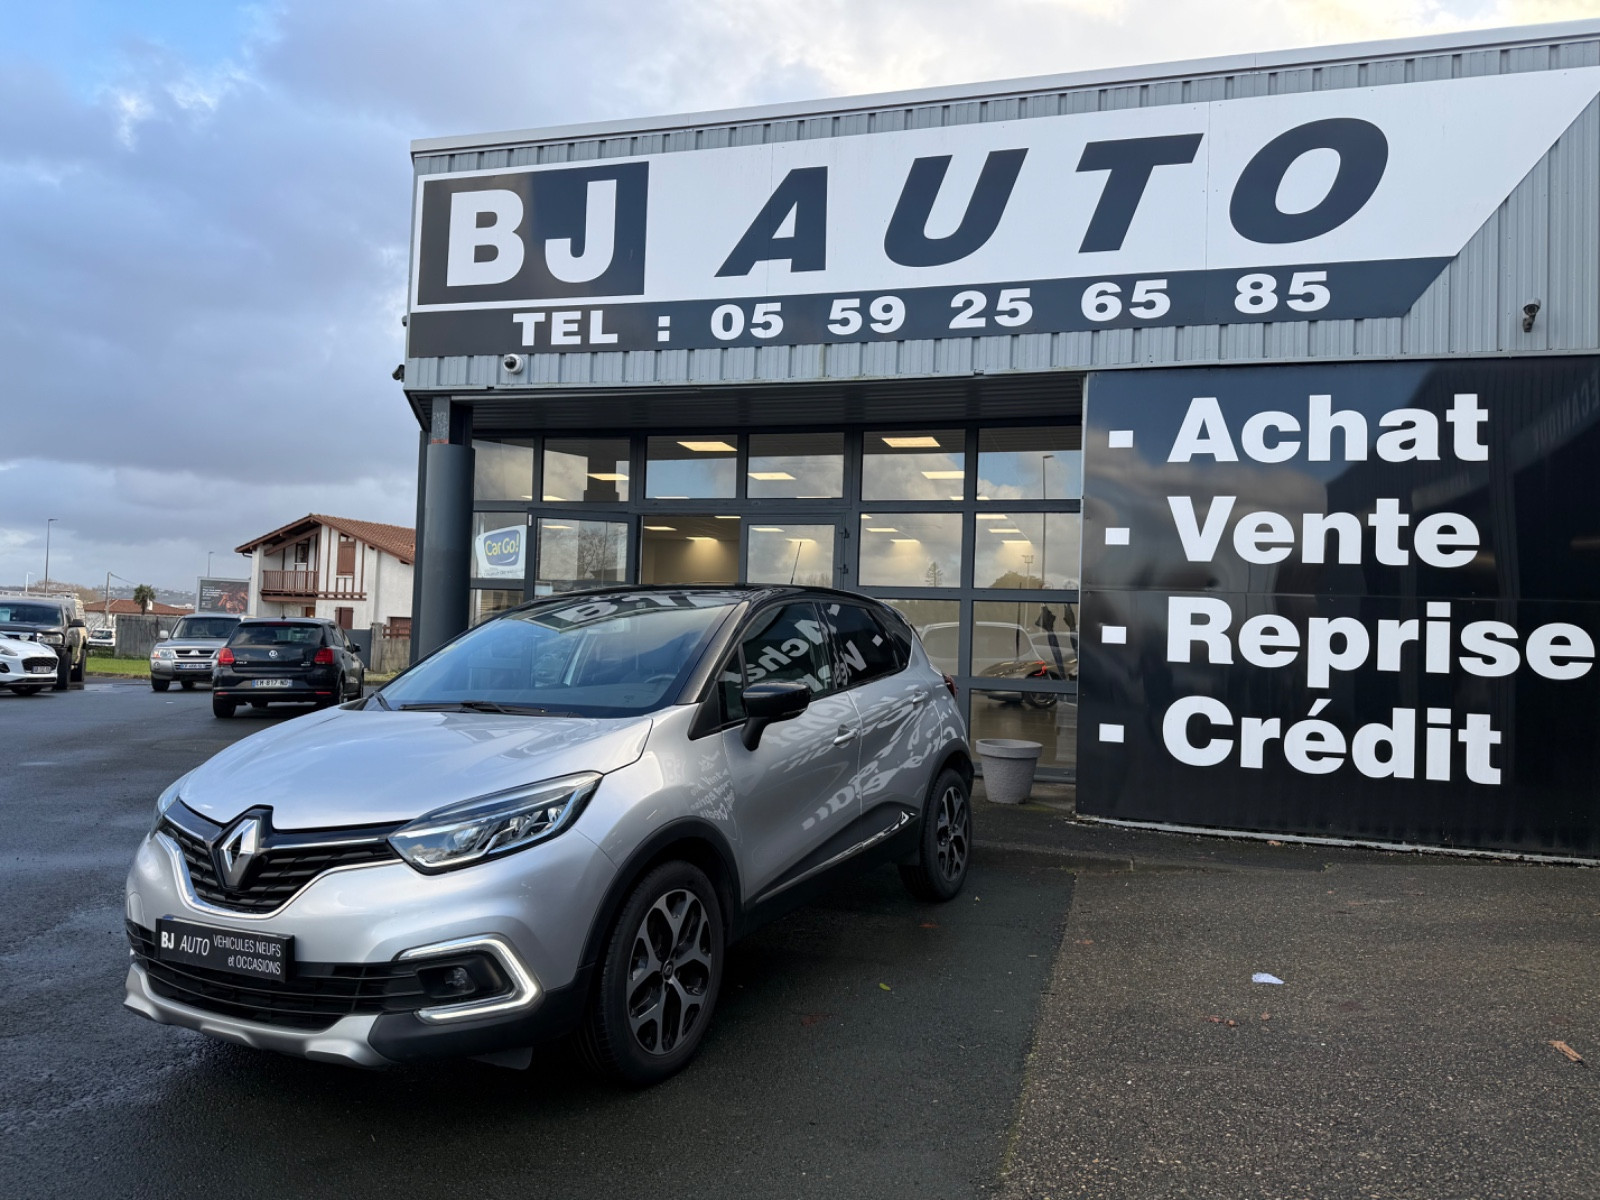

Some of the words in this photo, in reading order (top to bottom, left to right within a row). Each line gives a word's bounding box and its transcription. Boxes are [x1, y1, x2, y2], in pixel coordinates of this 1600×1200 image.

[447, 179, 617, 287] BJ
[714, 117, 1389, 278] AUTO
[513, 310, 618, 347] TEL
[711, 302, 784, 341] 05
[827, 295, 906, 335] 59
[948, 288, 1034, 329] 25
[1081, 279, 1171, 322] 65
[1234, 271, 1331, 314] 85
[1167, 393, 1489, 463] Achat
[1167, 496, 1480, 568] Vente
[1167, 596, 1596, 689] Reprise
[1162, 695, 1502, 785] Crédit
[161, 931, 175, 950] BJ
[179, 935, 210, 956] AUTO
[212, 934, 255, 953] VEHICULES
[255, 941, 281, 958] NEUFS
[228, 956, 235, 967] et
[236, 955, 281, 975] OCCASIONS
